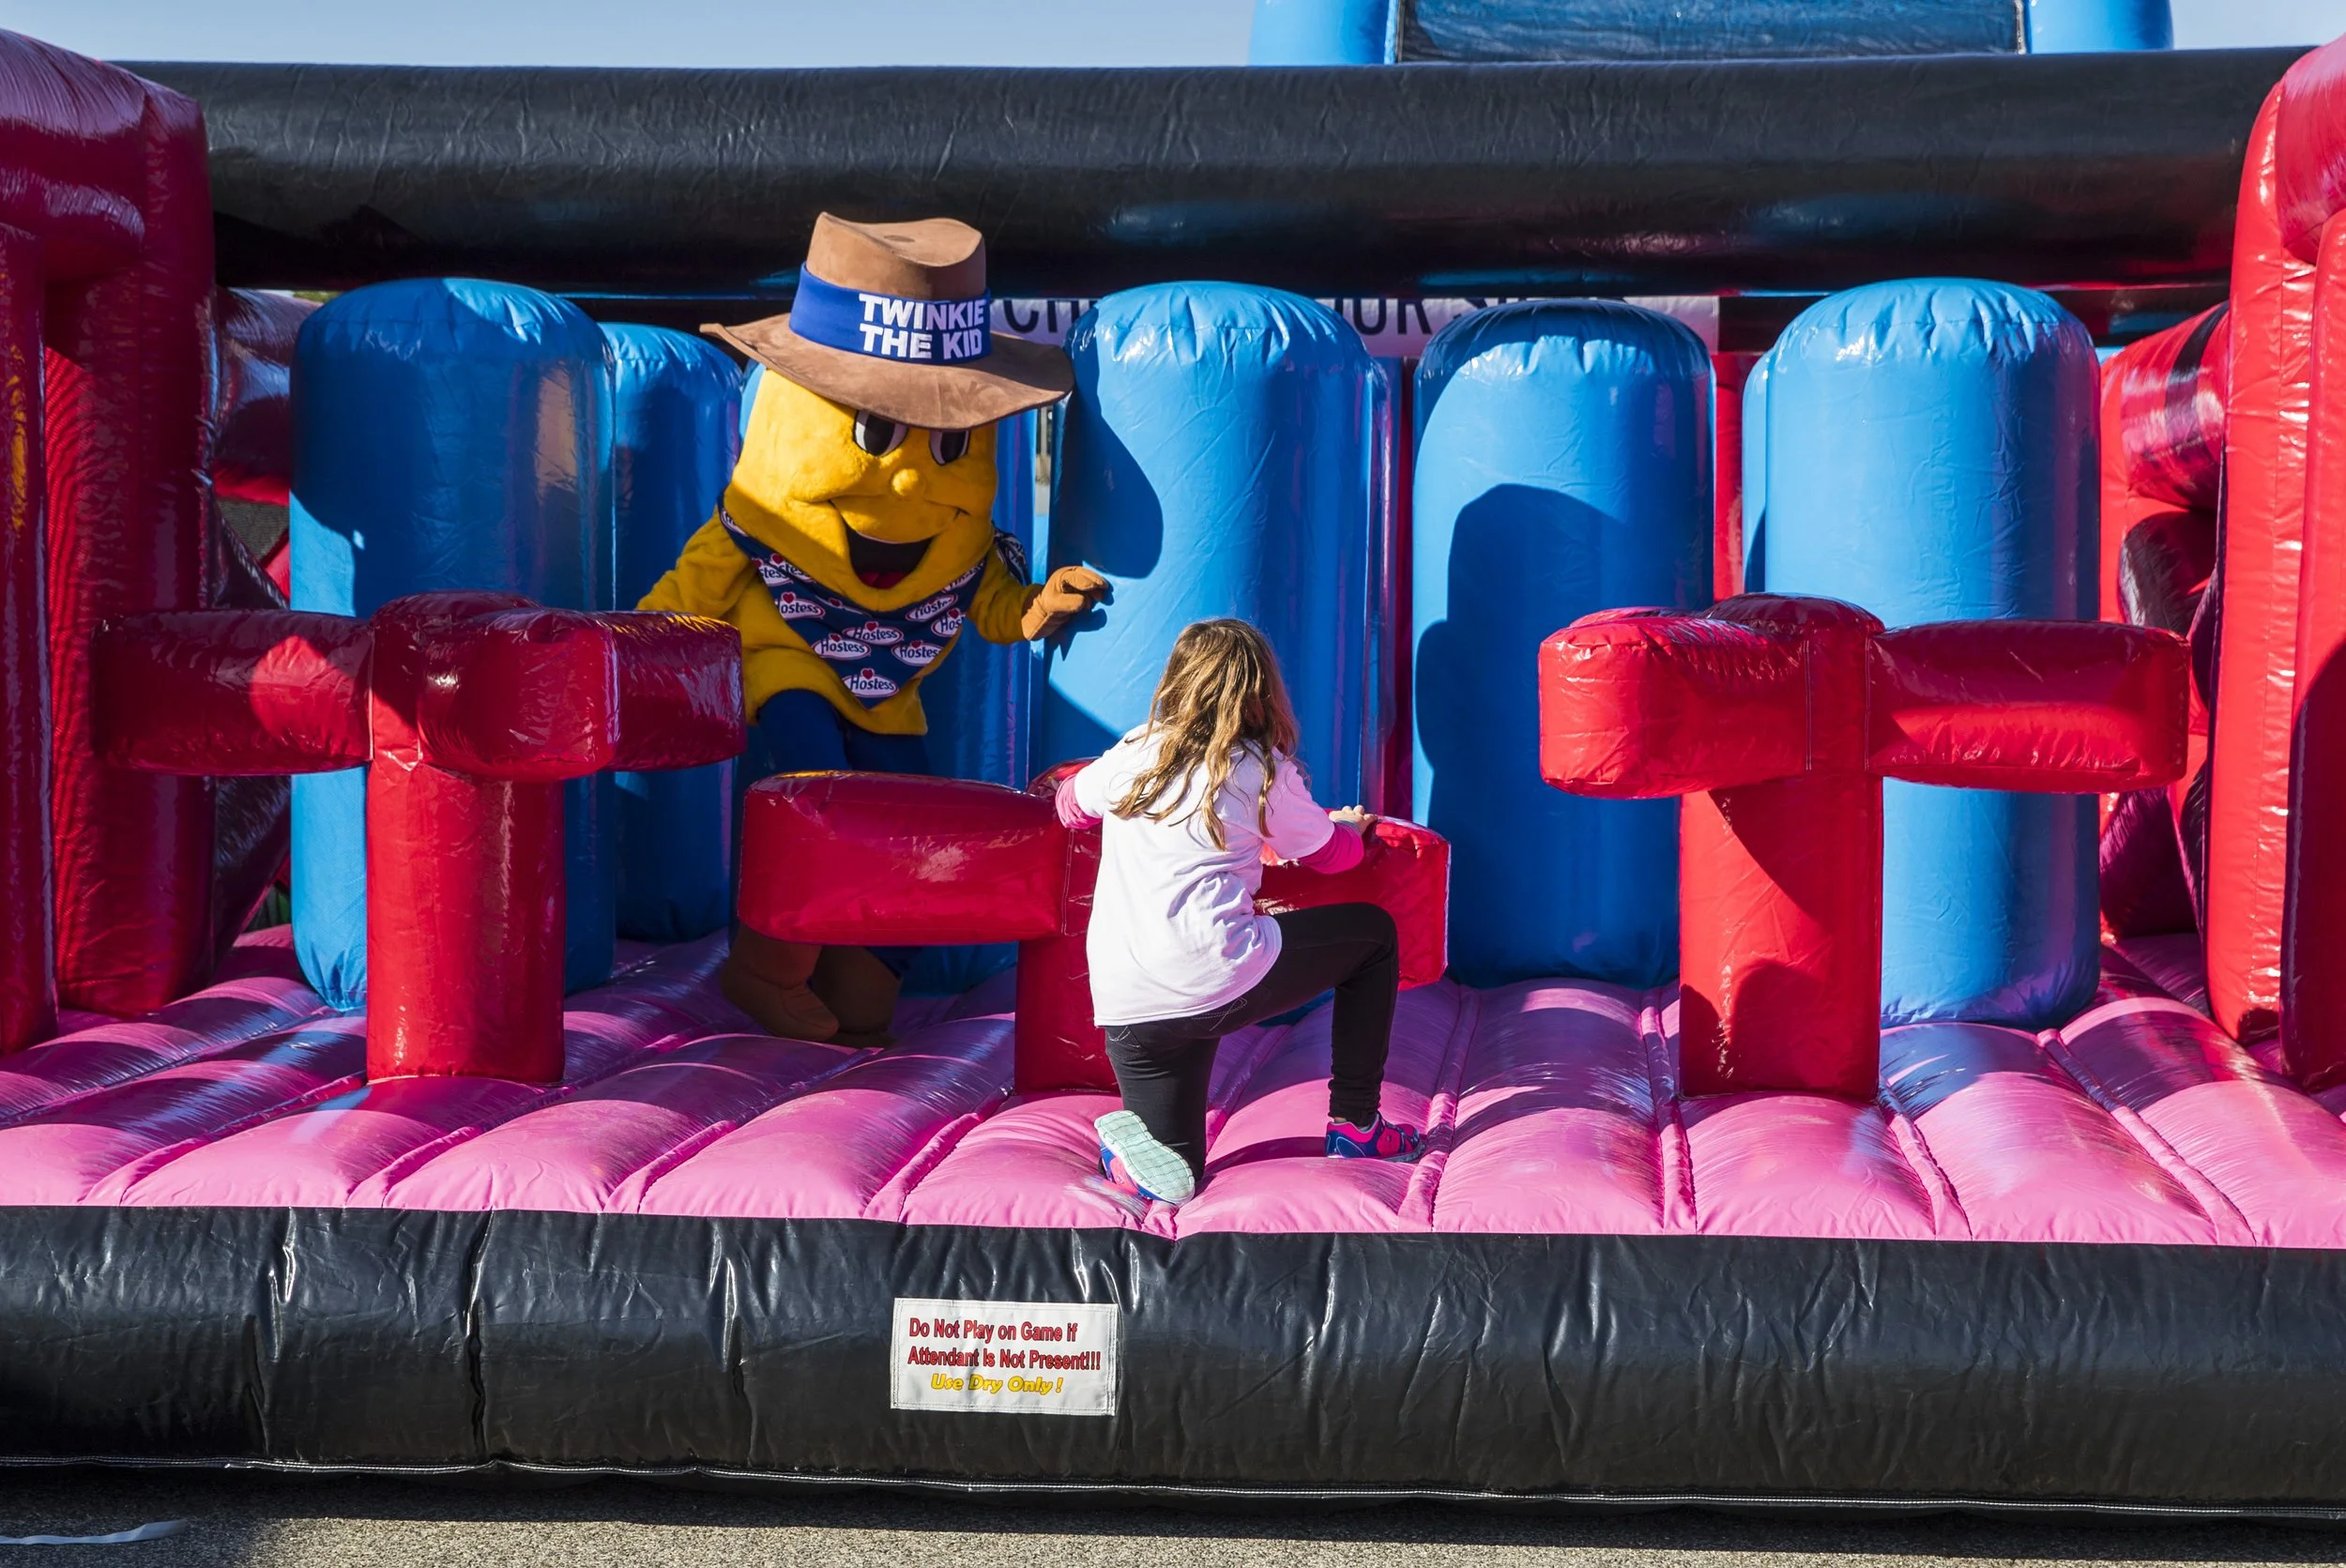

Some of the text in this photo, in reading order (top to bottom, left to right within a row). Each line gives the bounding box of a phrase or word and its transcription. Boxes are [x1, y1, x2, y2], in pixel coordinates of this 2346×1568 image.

[859, 293, 986, 331] TWINKIE
[860, 323, 983, 360] THE KID
[853, 627, 898, 641] Hostess
[820, 639, 865, 654] Hostess
[899, 646, 938, 659] Hostes
[849, 675, 894, 691] Hostess
[909, 1317, 930, 1338] Do
[934, 1318, 959, 1339] Not
[963, 1319, 994, 1343] Play
[998, 1324, 1016, 1341] on
[1020, 1321, 1062, 1342] Game
[907, 1346, 980, 1367] Attendant
[999, 1348, 1026, 1368] Not
[1028, 1349, 1102, 1370] Present!!!
[931, 1373, 965, 1391] Use
[968, 1374, 1003, 1394] Dry
